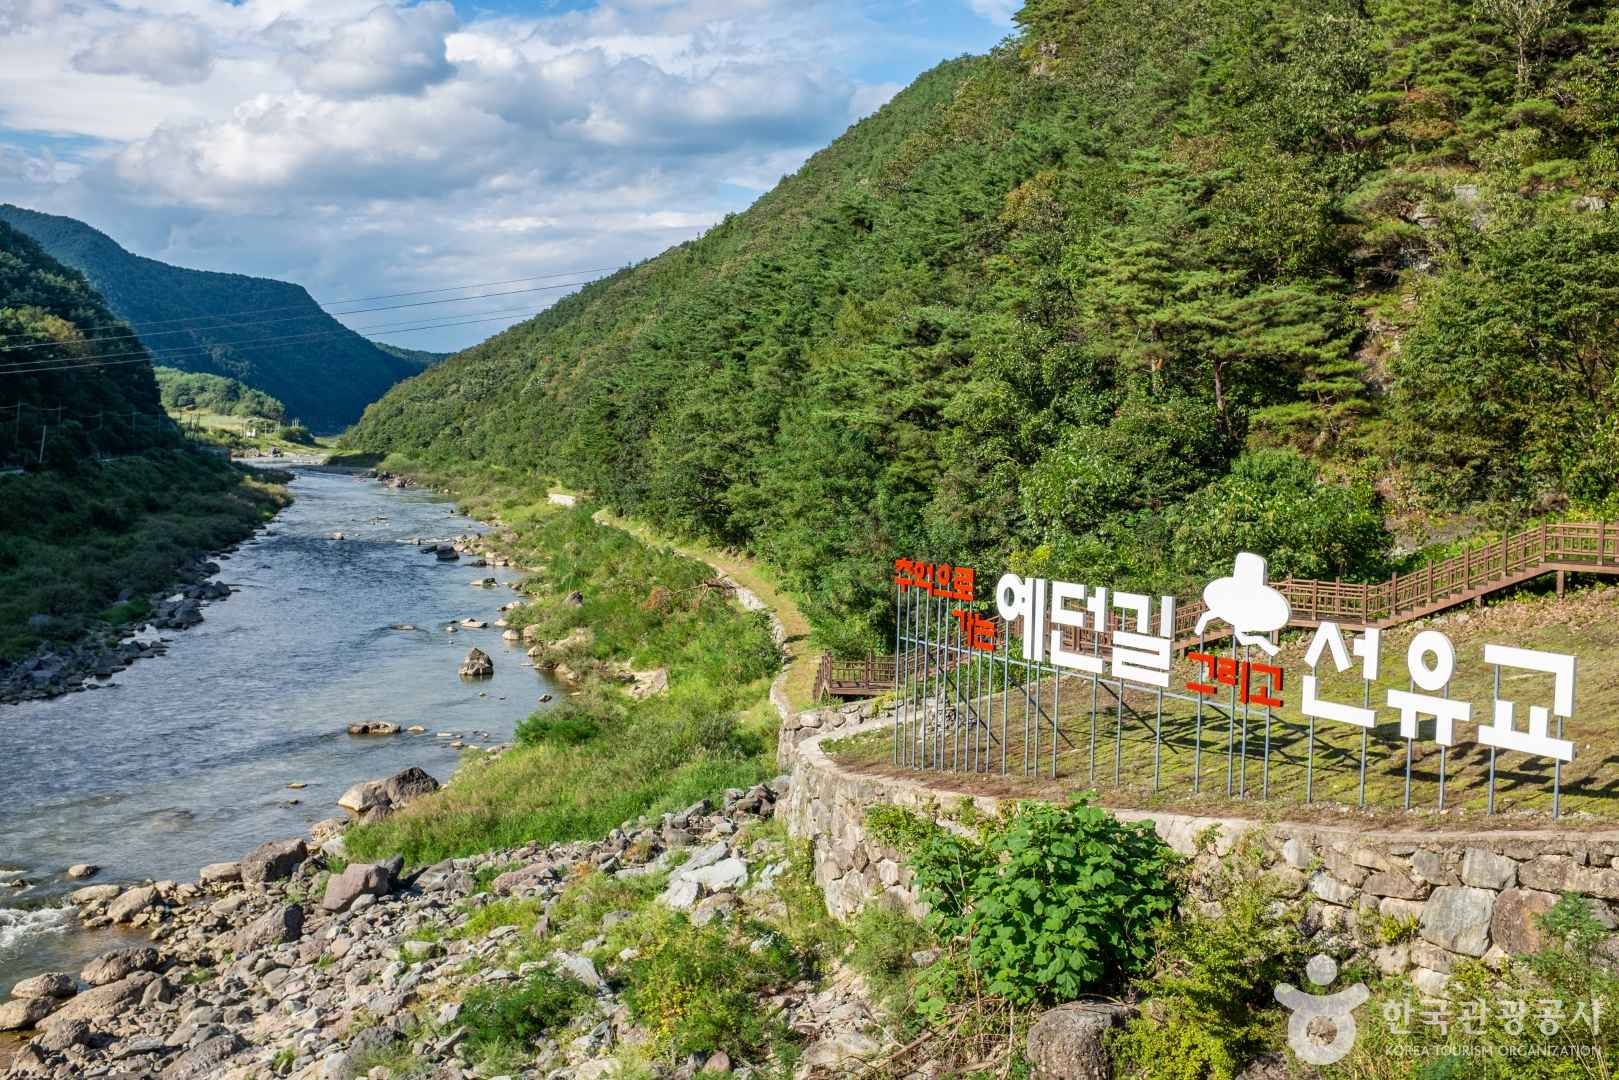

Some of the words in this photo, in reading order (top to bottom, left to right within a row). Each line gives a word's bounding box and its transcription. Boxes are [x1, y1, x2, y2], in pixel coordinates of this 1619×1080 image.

[952, 609, 995, 651] 가는
[996, 573, 1176, 688] 예던길
[1185, 651, 1284, 708] 그리고
[1302, 622, 1577, 762] 선유교
